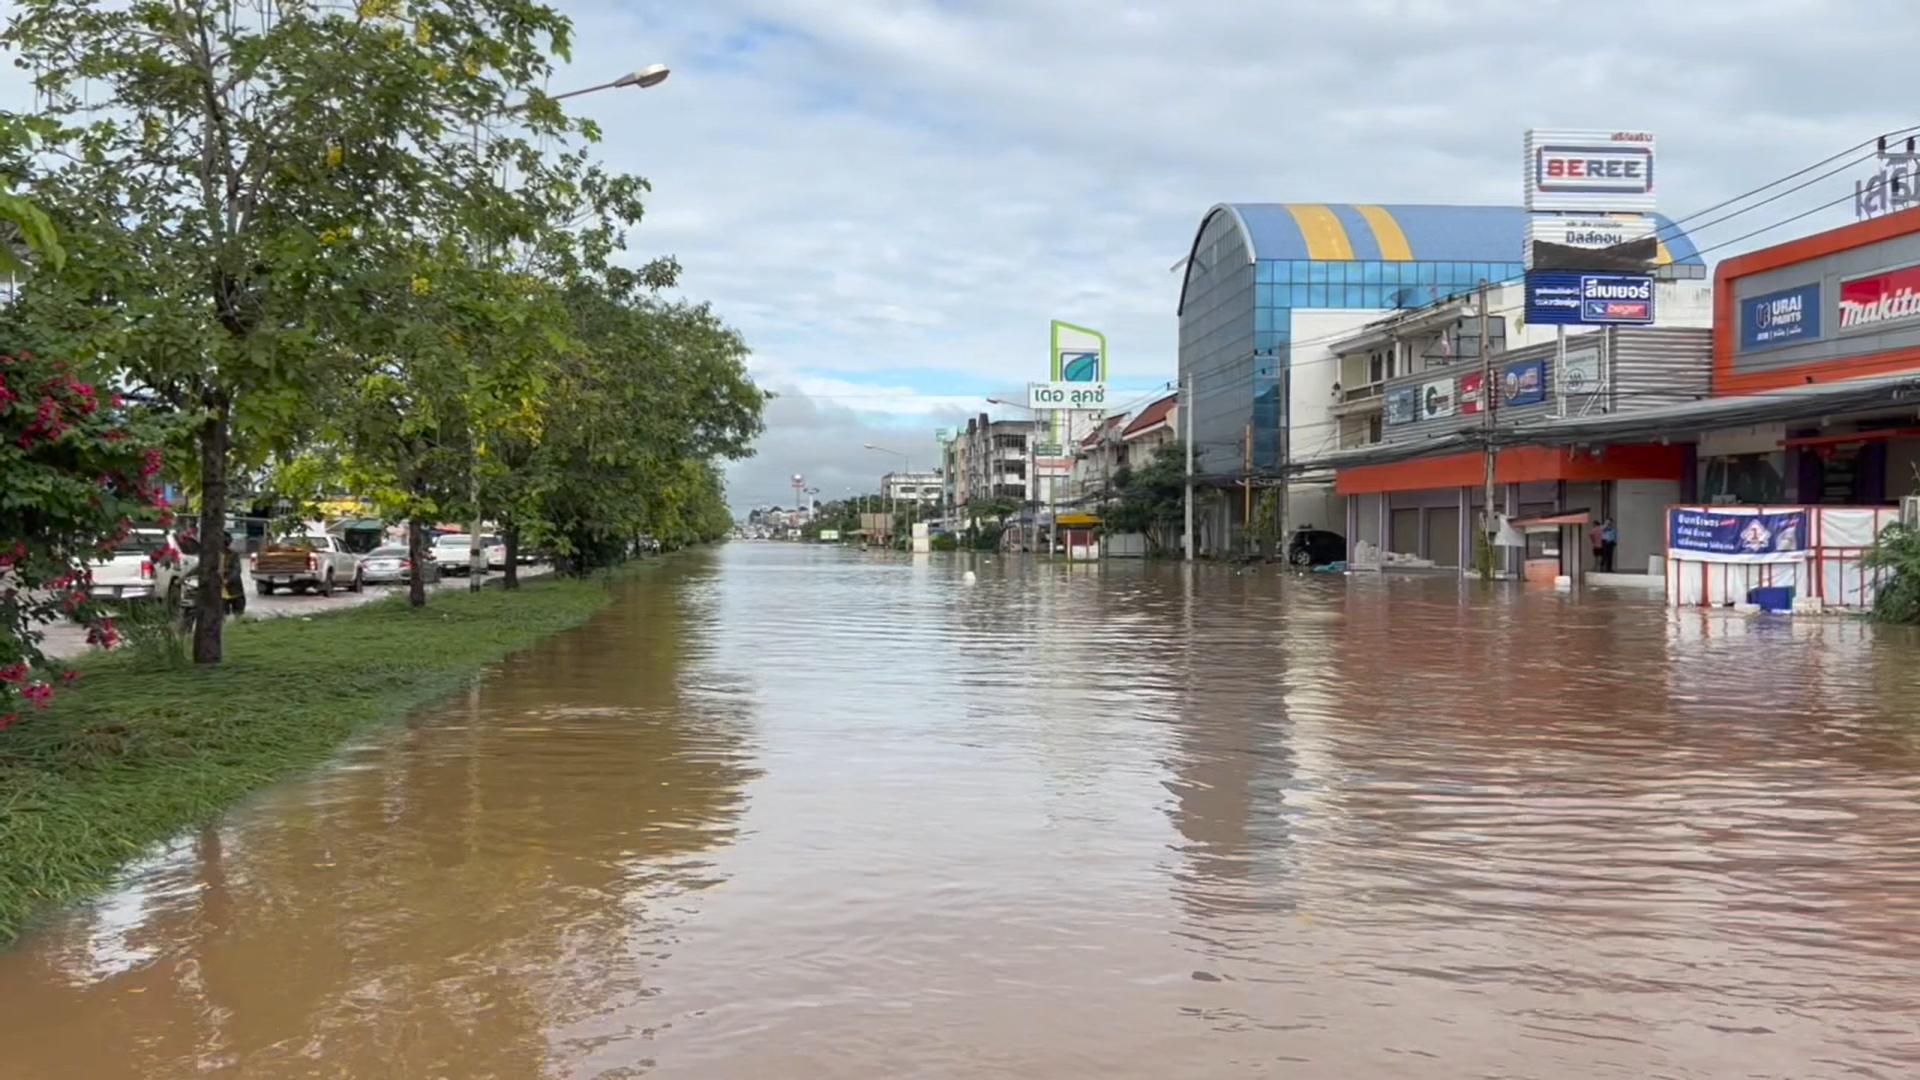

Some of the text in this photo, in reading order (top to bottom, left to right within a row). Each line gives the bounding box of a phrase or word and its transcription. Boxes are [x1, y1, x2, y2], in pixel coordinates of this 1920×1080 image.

[1547, 159, 1641, 178] BEREE
[1585, 279, 1650, 299] สีเบเยอร์
[1772, 295, 1802, 315] URAI
[1035, 389, 1064, 402] เดอ
